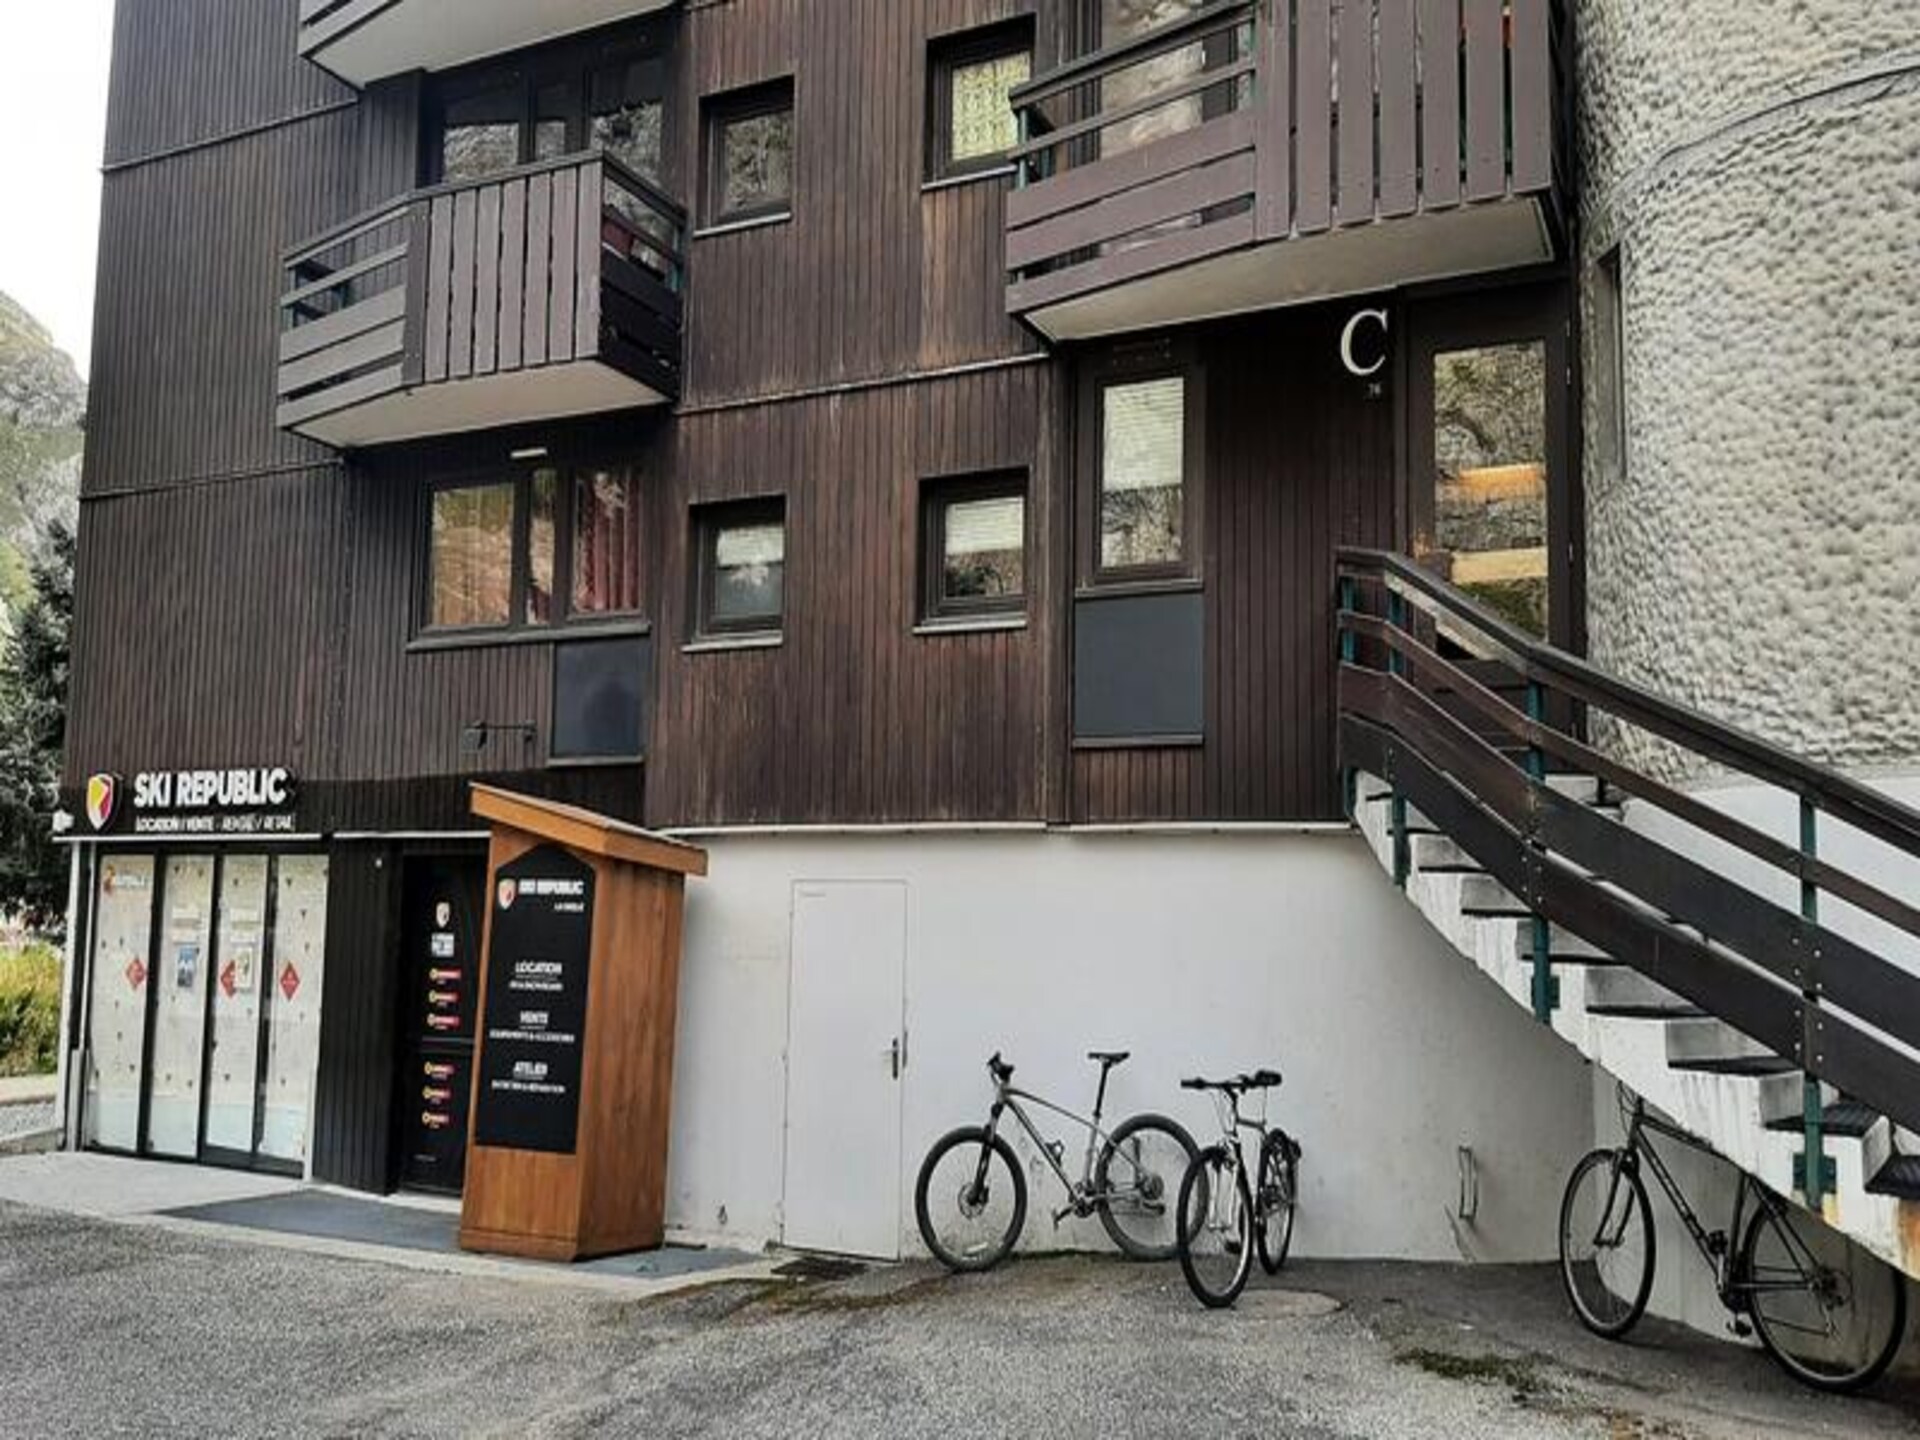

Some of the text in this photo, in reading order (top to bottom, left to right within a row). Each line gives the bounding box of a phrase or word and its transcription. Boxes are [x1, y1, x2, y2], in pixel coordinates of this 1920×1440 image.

[1341, 308, 1388, 375] C
[133, 767, 288, 808] SKI REPUBLIC
[537, 879, 585, 895] REPUBLIC
[514, 961, 562, 974] LOCATION
[520, 1011, 549, 1024] VENTE
[513, 1061, 549, 1076] ATELIER
